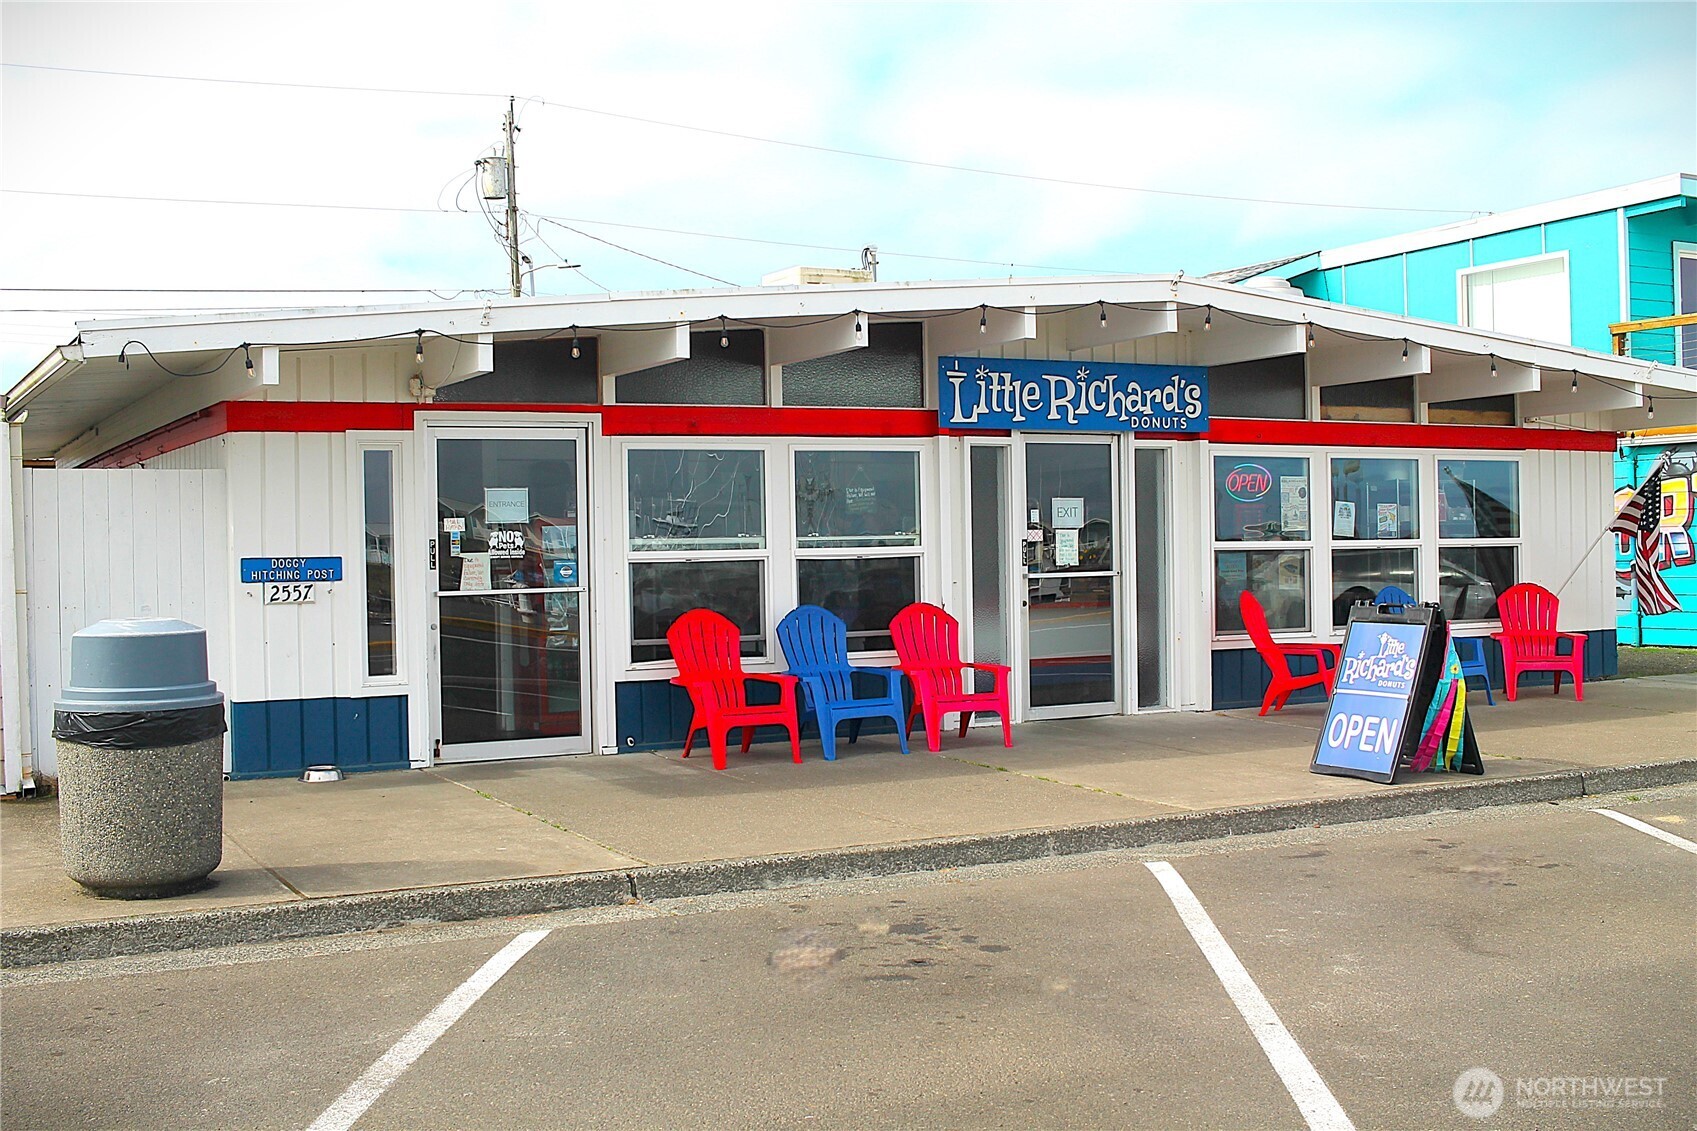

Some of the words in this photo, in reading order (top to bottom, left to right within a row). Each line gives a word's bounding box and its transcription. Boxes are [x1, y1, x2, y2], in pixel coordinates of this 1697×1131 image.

[947, 360, 1043, 423] Little
[1042, 366, 1203, 424] Richard's
[1131, 416, 1188, 429] DONUTS
[1228, 473, 1268, 492] OPEN
[489, 500, 525, 508] ENTRANCE
[1057, 506, 1078, 518] EXIT
[498, 530, 515, 543] NO
[271, 558, 307, 569] DOGGY
[251, 570, 301, 580] HITCHING
[307, 569, 335, 579] POST
[269, 583, 314, 603] 2557
[1377, 634, 1406, 659] Little
[1341, 651, 1417, 684] Richard's
[1377, 680, 1406, 689] DONUTS
[1328, 712, 1398, 755] OPEN
